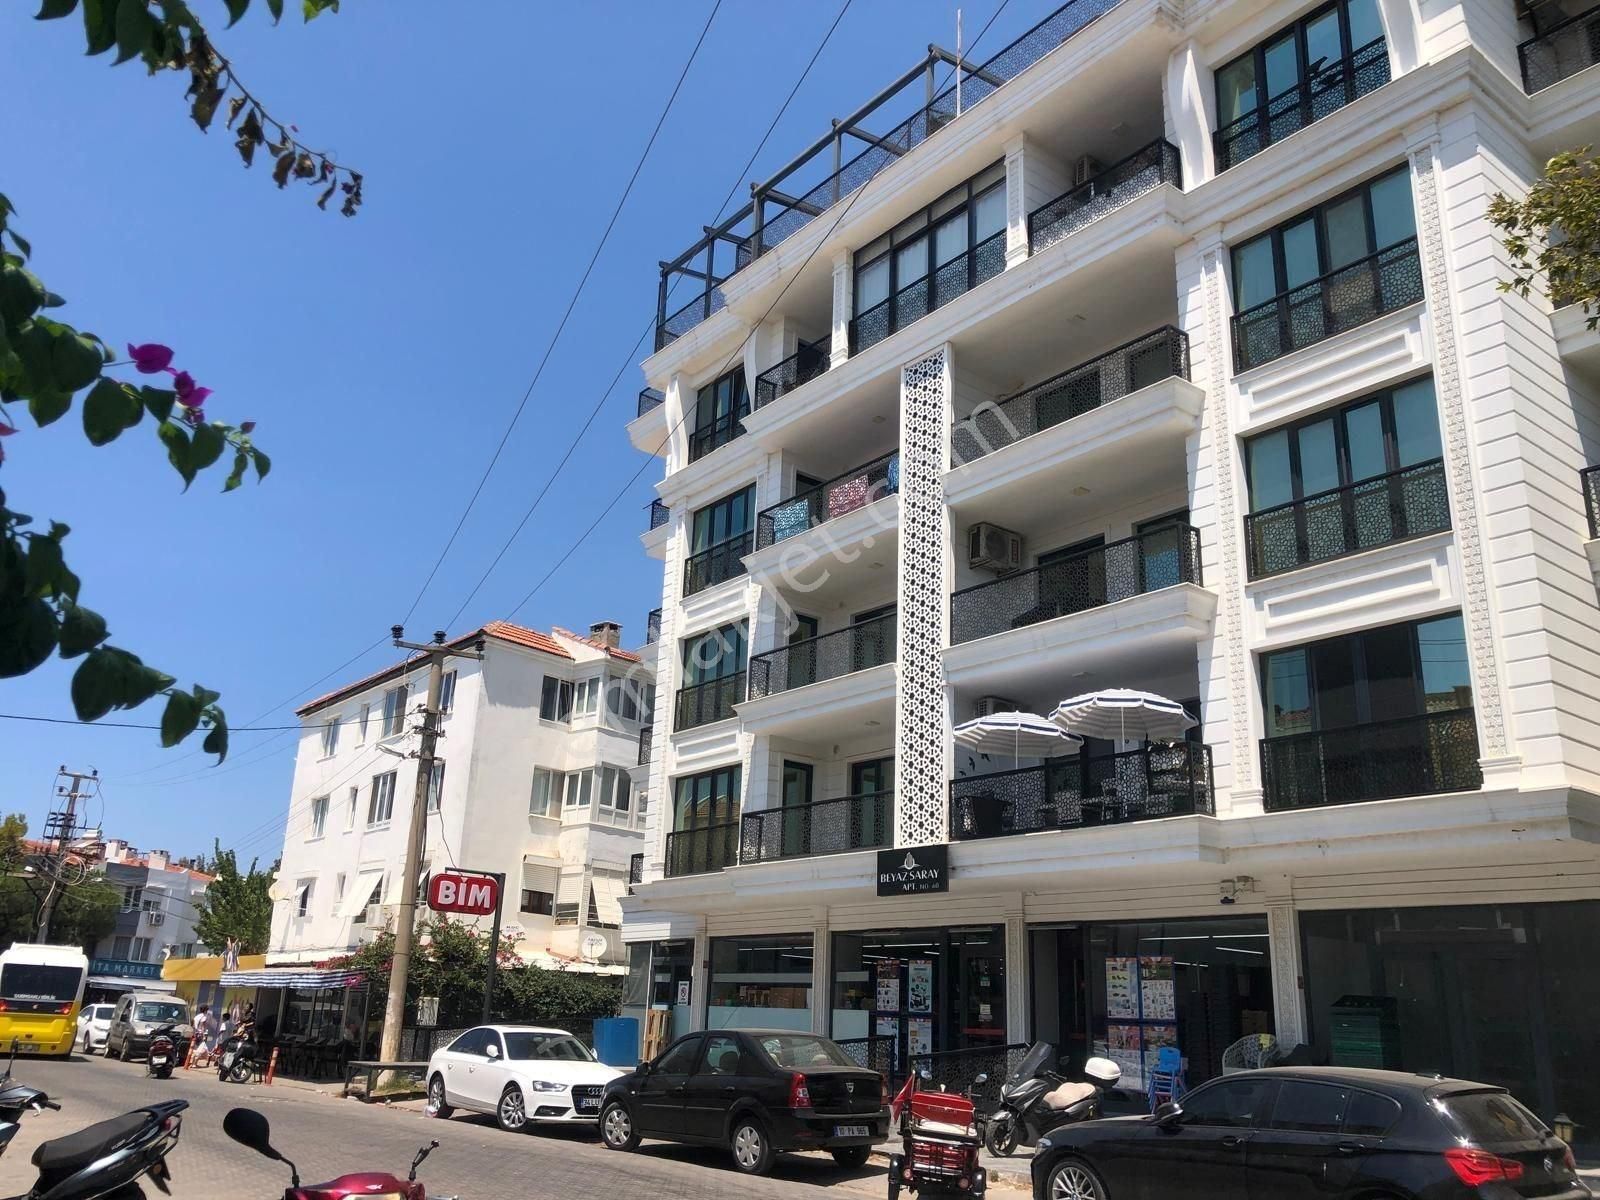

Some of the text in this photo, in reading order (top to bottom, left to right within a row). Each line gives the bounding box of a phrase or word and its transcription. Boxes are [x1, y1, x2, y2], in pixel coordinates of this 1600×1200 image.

[880, 868, 940, 883] BEYAZ SARAY
[437, 877, 491, 909] BİM
[902, 882, 918, 891] APT.
[114, 964, 156, 975] MARKET
